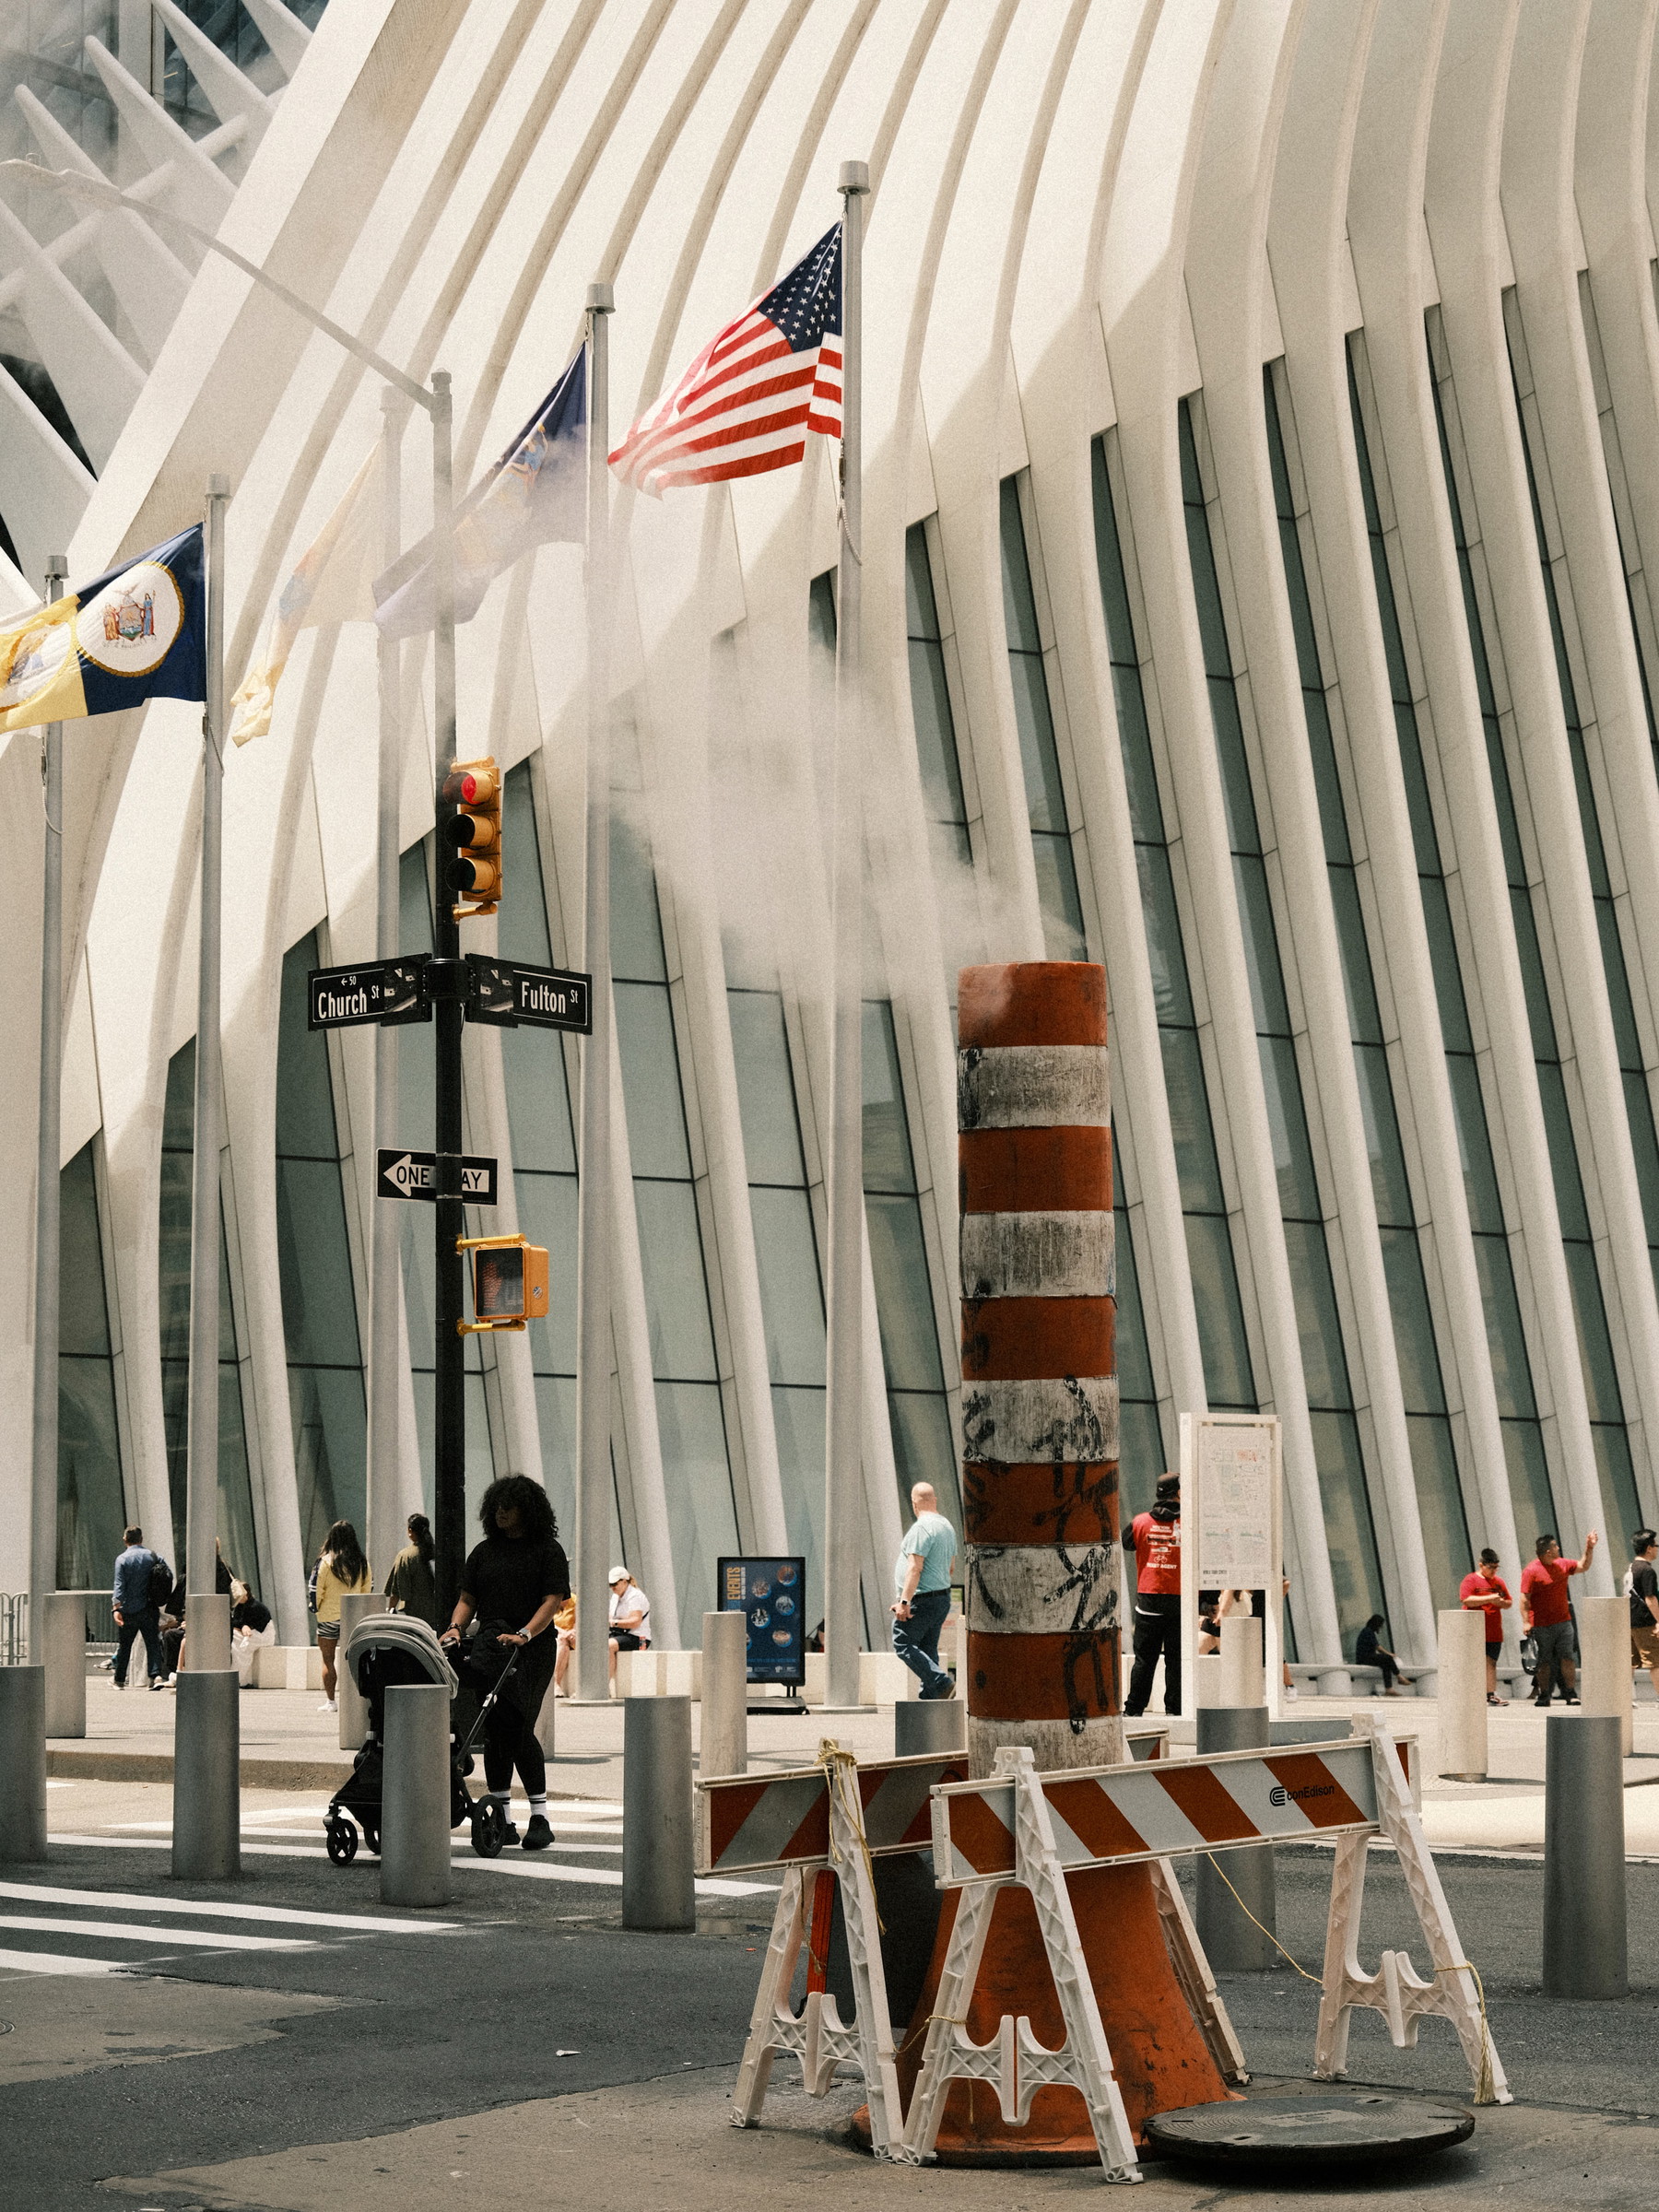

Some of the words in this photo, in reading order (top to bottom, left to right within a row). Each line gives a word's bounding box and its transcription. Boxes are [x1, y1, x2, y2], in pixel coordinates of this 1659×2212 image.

[348, 975, 357, 985] 50
[317, 988, 368, 1019] Church
[371, 985, 380, 1000] St
[521, 981, 567, 1014] Fulton
[570, 989, 579, 1004] St
[396, 1165, 430, 1186] ONE
[462, 1171, 482, 1190] AY
[726, 1567, 741, 1600] EVENTS
[1287, 1785, 1335, 1800] conEdison
